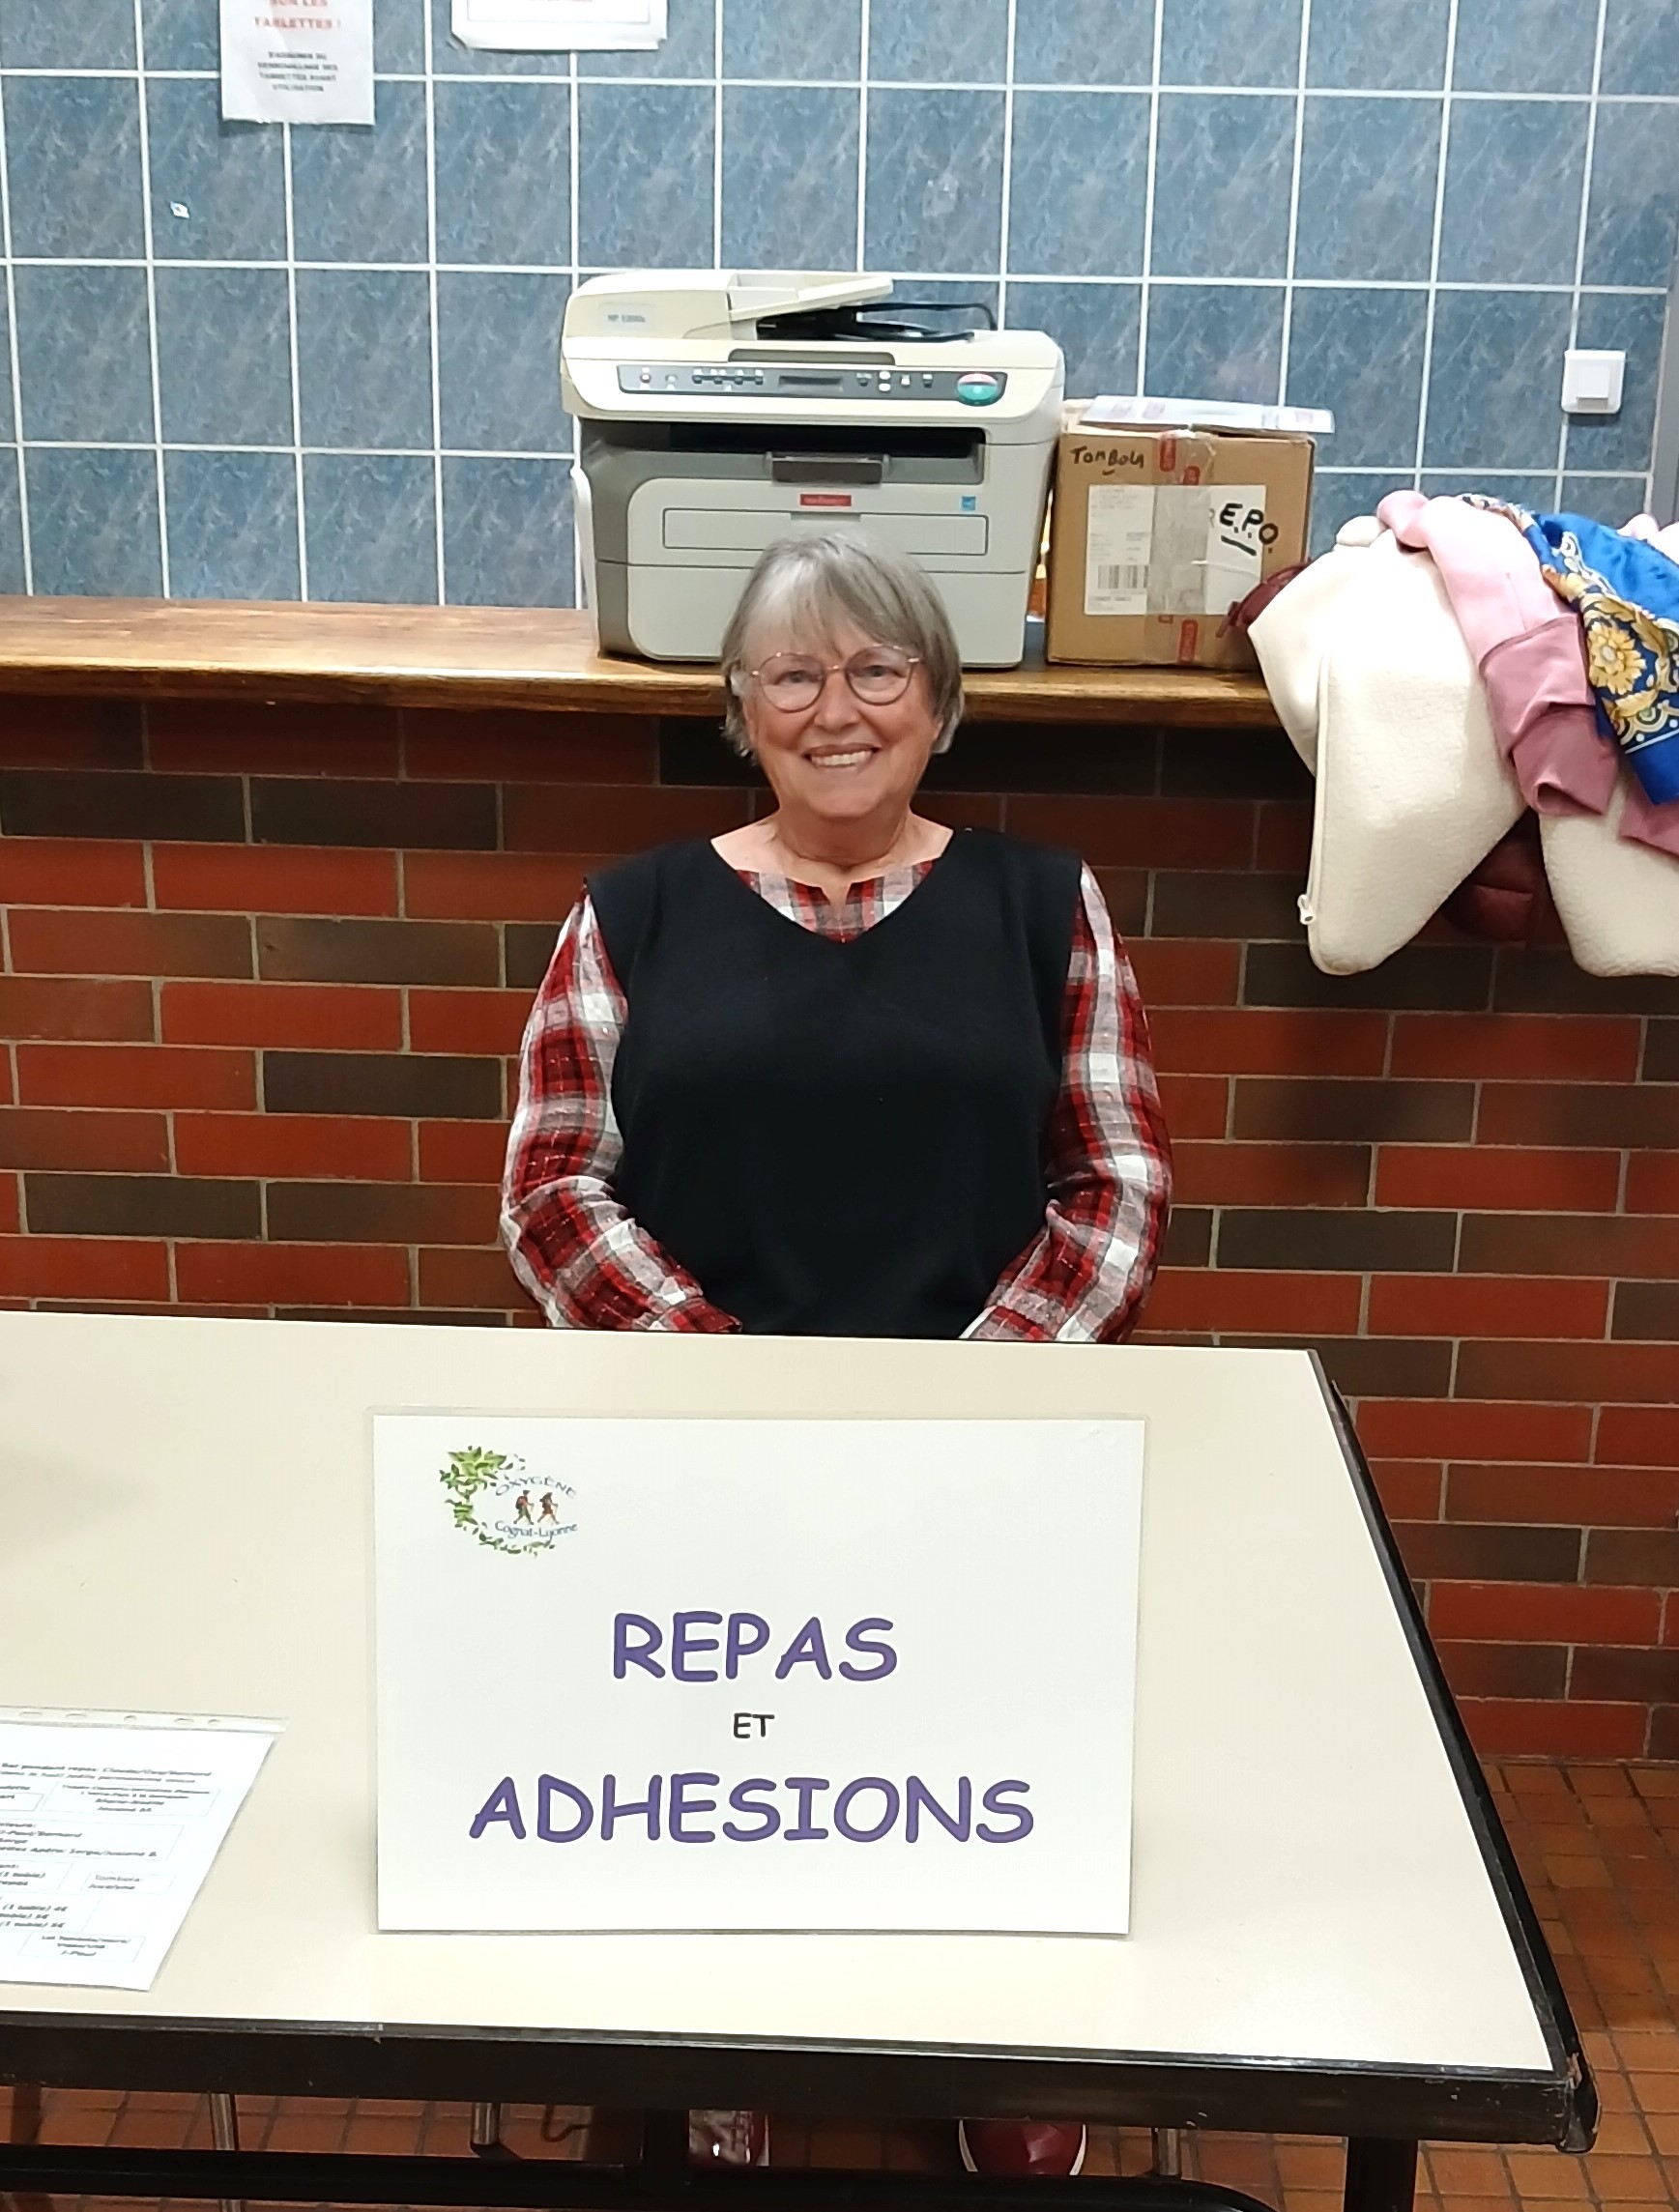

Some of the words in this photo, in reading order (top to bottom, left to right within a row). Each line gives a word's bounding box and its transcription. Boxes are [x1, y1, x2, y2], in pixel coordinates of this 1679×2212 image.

[613, 1610, 898, 1683] REPAS
[733, 1711, 775, 1739] ET
[469, 1771, 1034, 1844] ADHESIONS
